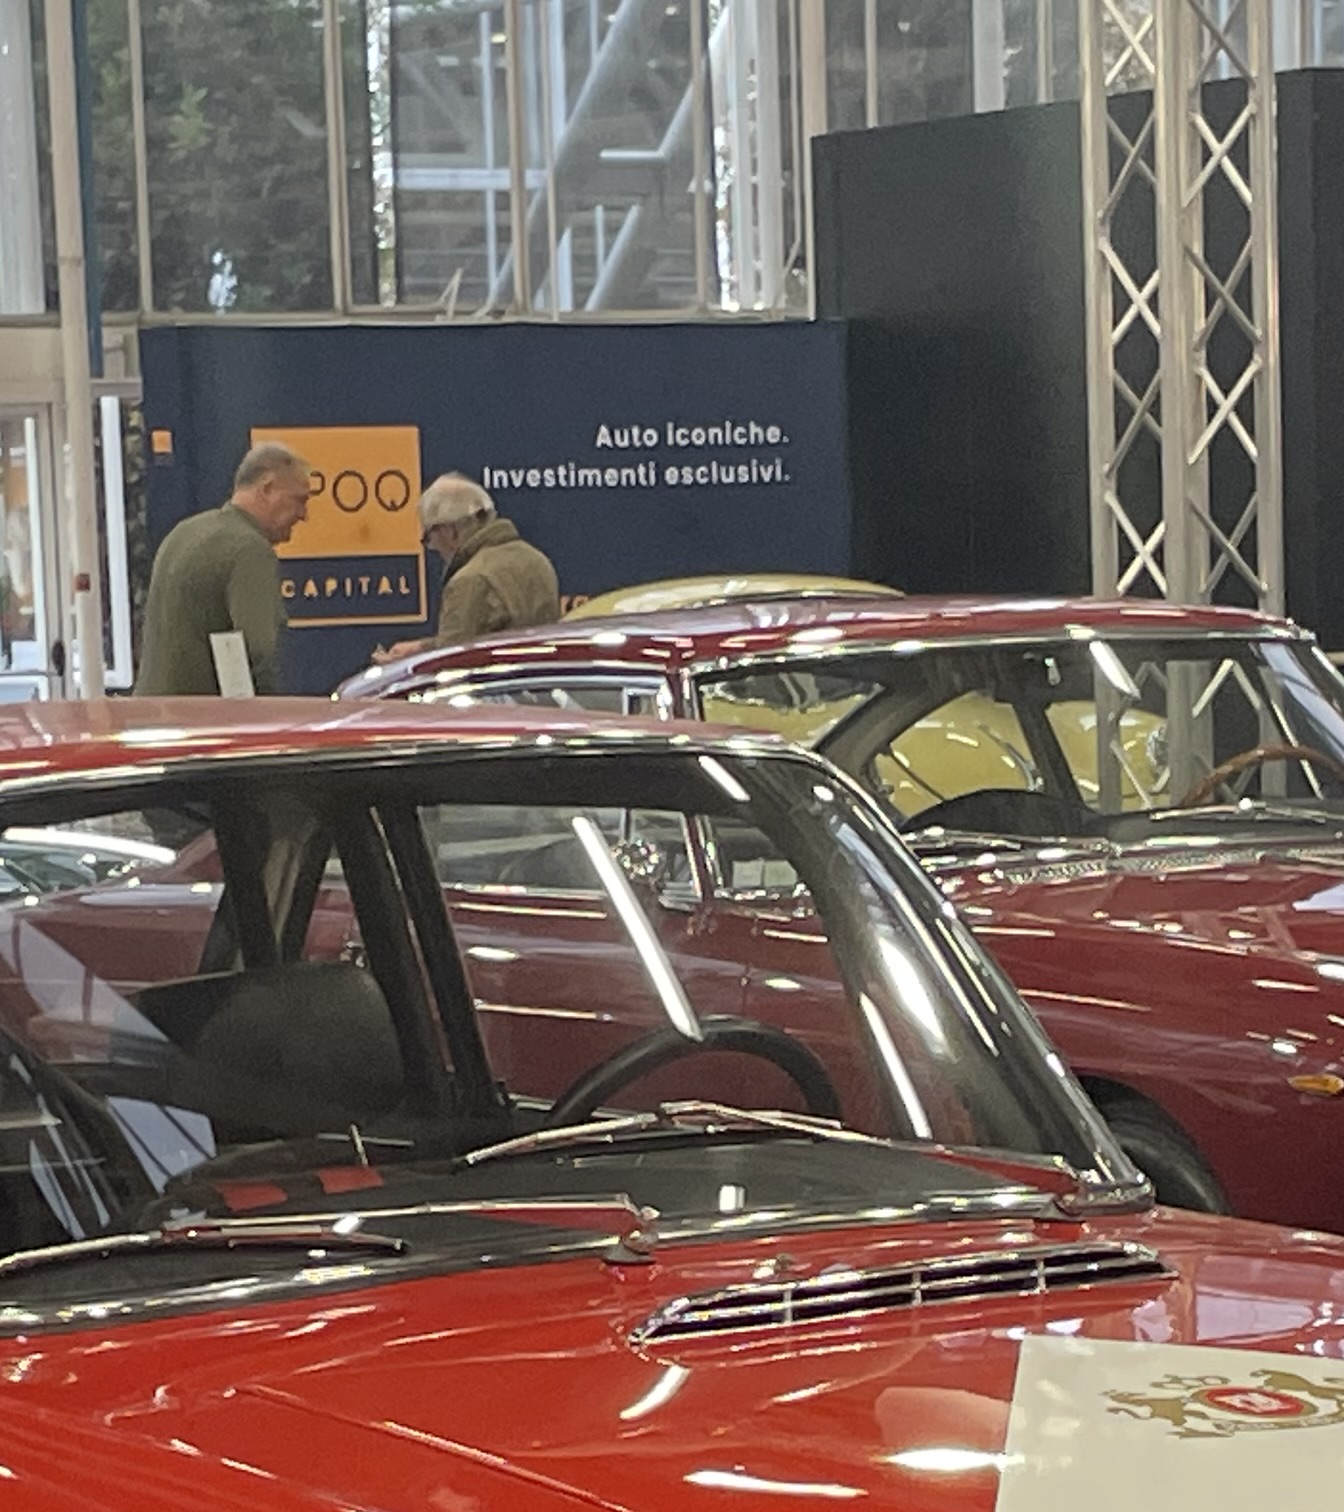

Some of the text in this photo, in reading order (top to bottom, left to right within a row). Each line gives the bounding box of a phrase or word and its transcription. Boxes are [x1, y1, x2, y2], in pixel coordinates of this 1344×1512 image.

[596, 421, 790, 449] Auto iconiche.
[483, 458, 791, 489] Investimenti esclusivi.
[280, 575, 410, 598] CAPITAL
